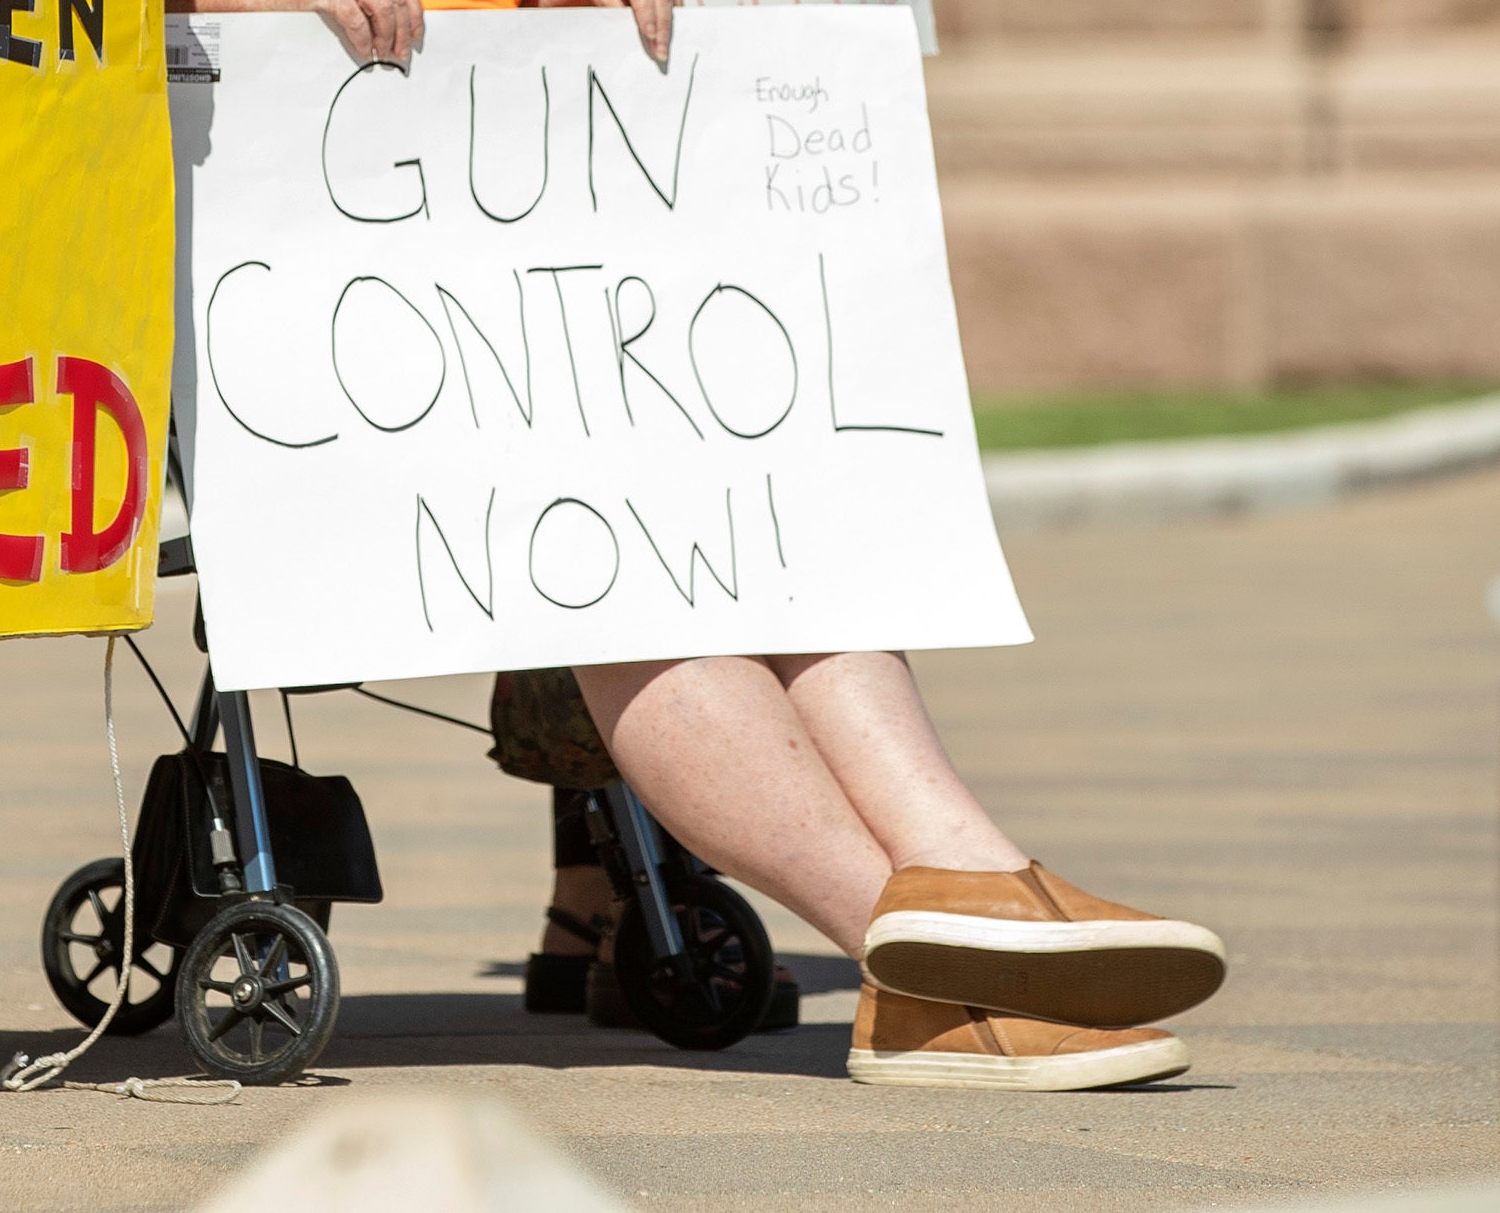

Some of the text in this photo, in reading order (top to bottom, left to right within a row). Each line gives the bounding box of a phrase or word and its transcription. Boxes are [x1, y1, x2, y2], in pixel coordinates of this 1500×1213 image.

[321, 53, 698, 224] GUN
[755, 75, 830, 114] Enough
[765, 101, 872, 160] Dead
[765, 160, 880, 214] Kids!
[206, 253, 944, 448] CONTROL
[416, 474, 795, 633] NOW!
